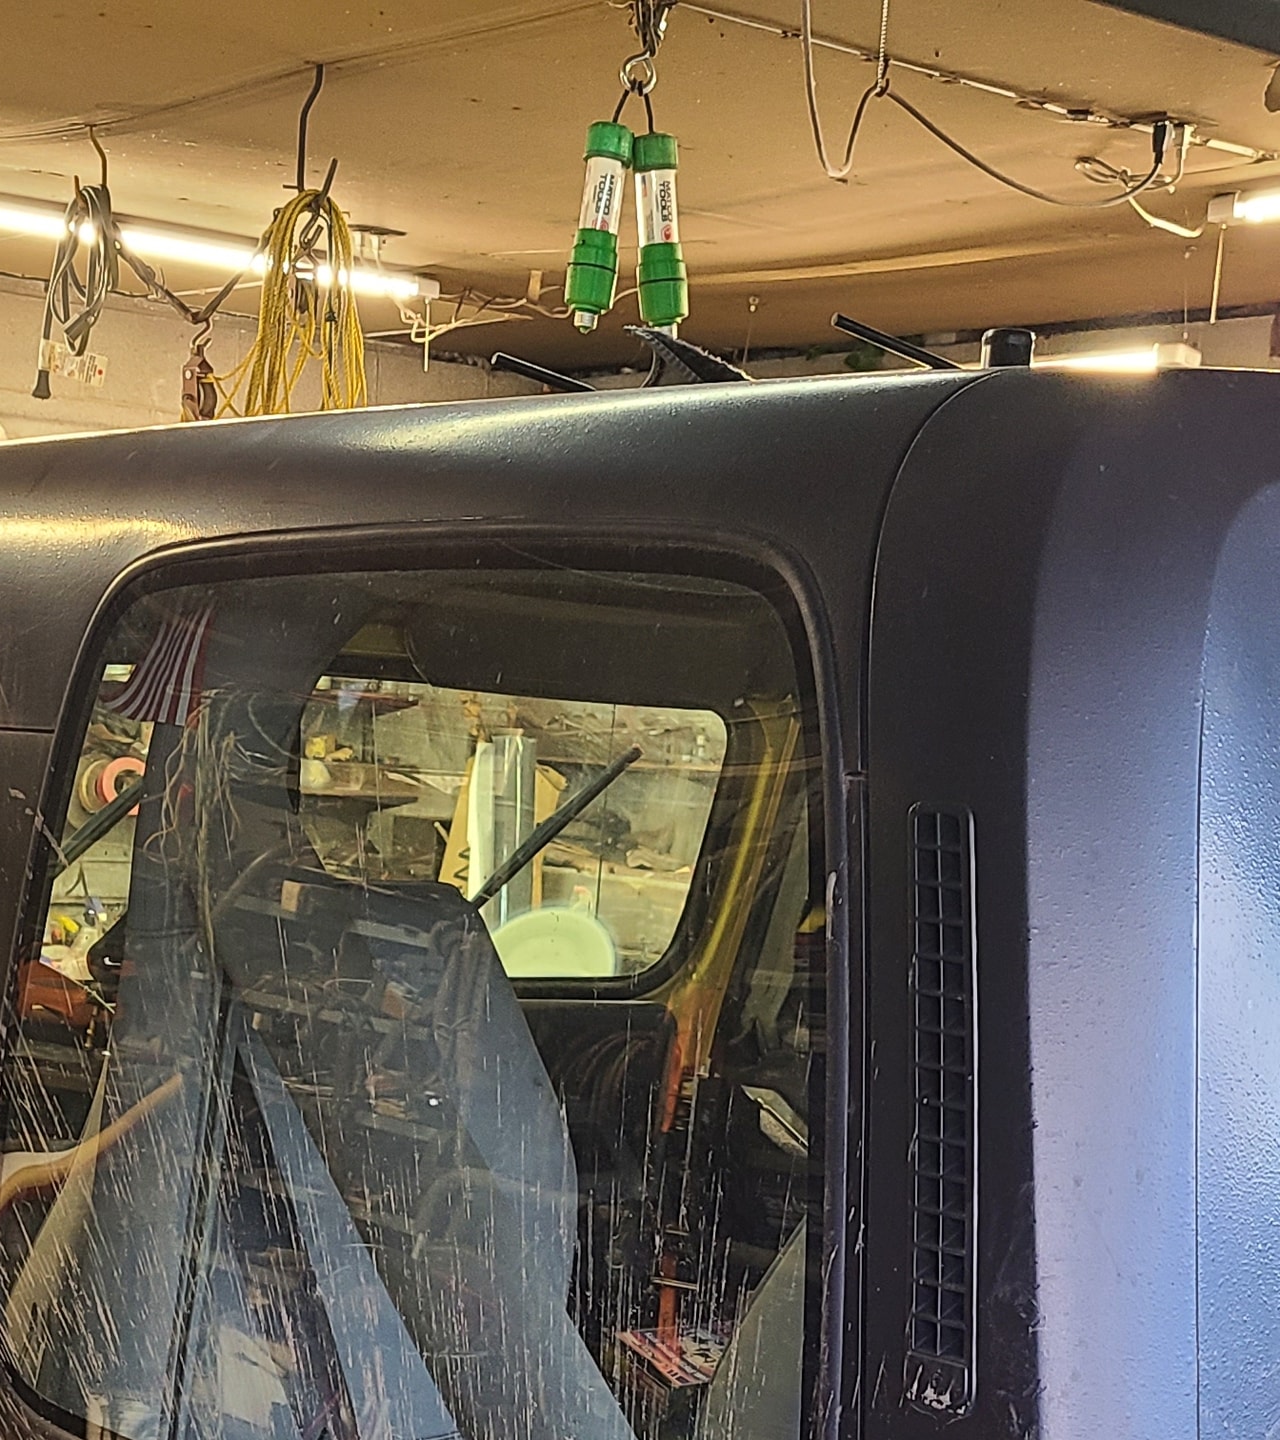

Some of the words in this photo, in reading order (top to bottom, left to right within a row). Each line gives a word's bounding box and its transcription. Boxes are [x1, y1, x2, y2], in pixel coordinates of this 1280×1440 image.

[603, 174, 615, 215] MATCO
[658, 180, 669, 222] TOOLS
[663, 180, 673, 222] MATCO
